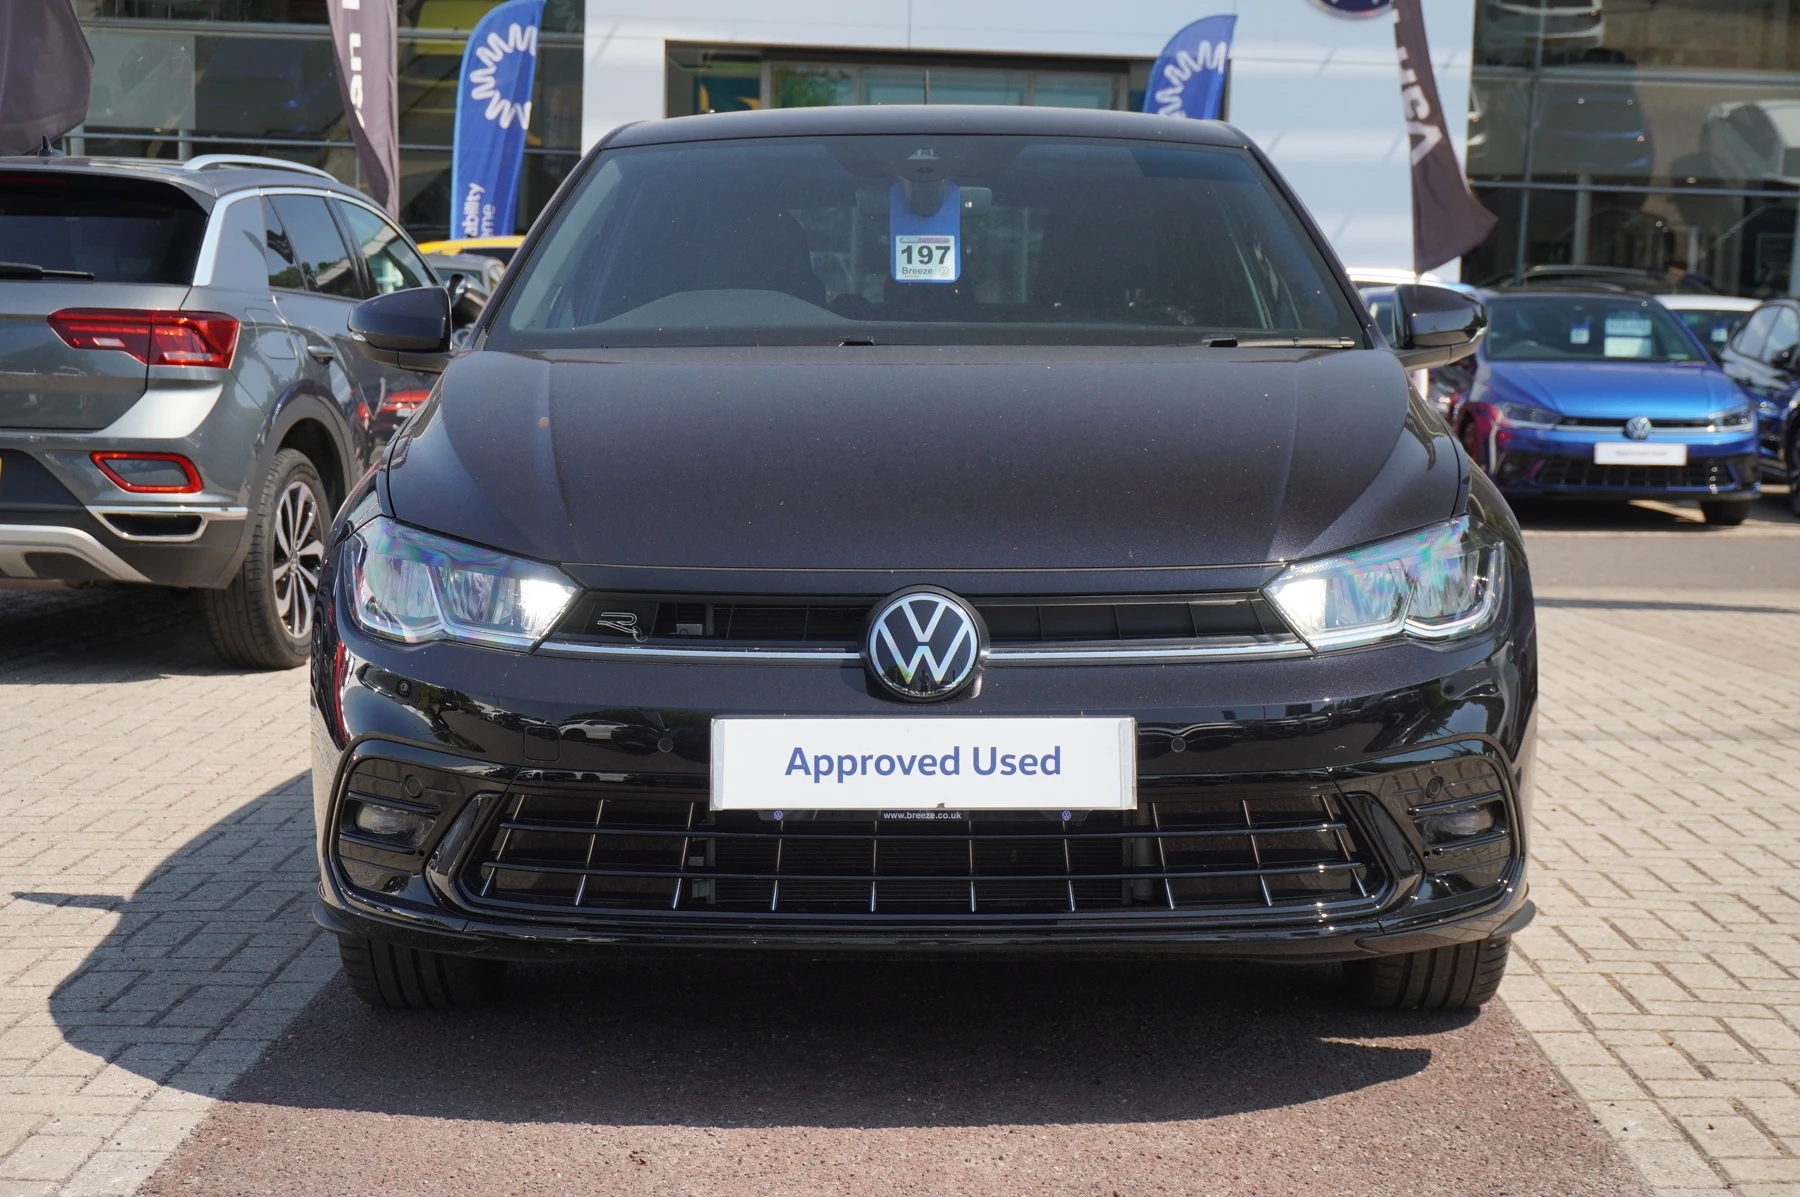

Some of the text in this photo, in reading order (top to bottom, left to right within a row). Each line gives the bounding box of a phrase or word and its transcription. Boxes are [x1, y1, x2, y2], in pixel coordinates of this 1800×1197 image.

[461, 181, 485, 237] ability
[901, 244, 951, 265] 197
[901, 266, 933, 275] Breeze
[785, 746, 1061, 784] Approved Used
[883, 811, 962, 820] www.breeze.co.uk
